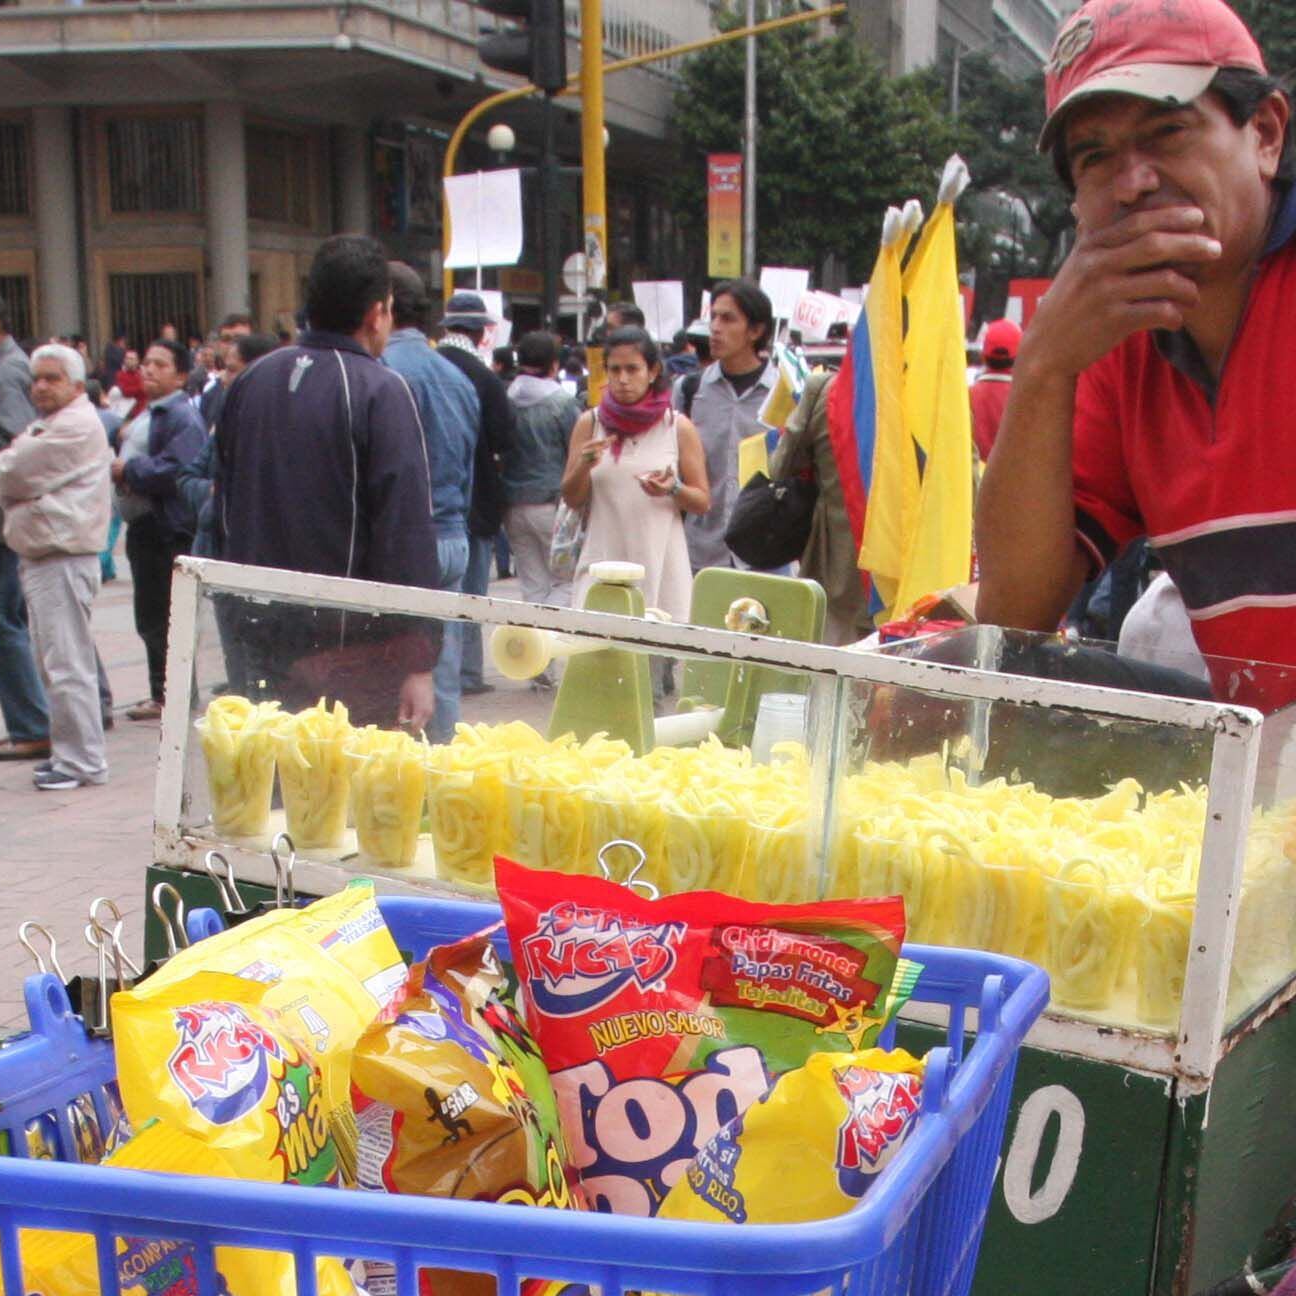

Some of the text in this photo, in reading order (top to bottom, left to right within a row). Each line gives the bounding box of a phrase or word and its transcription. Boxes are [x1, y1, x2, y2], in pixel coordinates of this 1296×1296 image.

[721, 925, 860, 977] Chicharrones
[731, 953, 852, 1003] Papas Fritas
[735, 979, 828, 1018] Tajaditas
[588, 1010, 727, 1055] NUEVO SABOR
